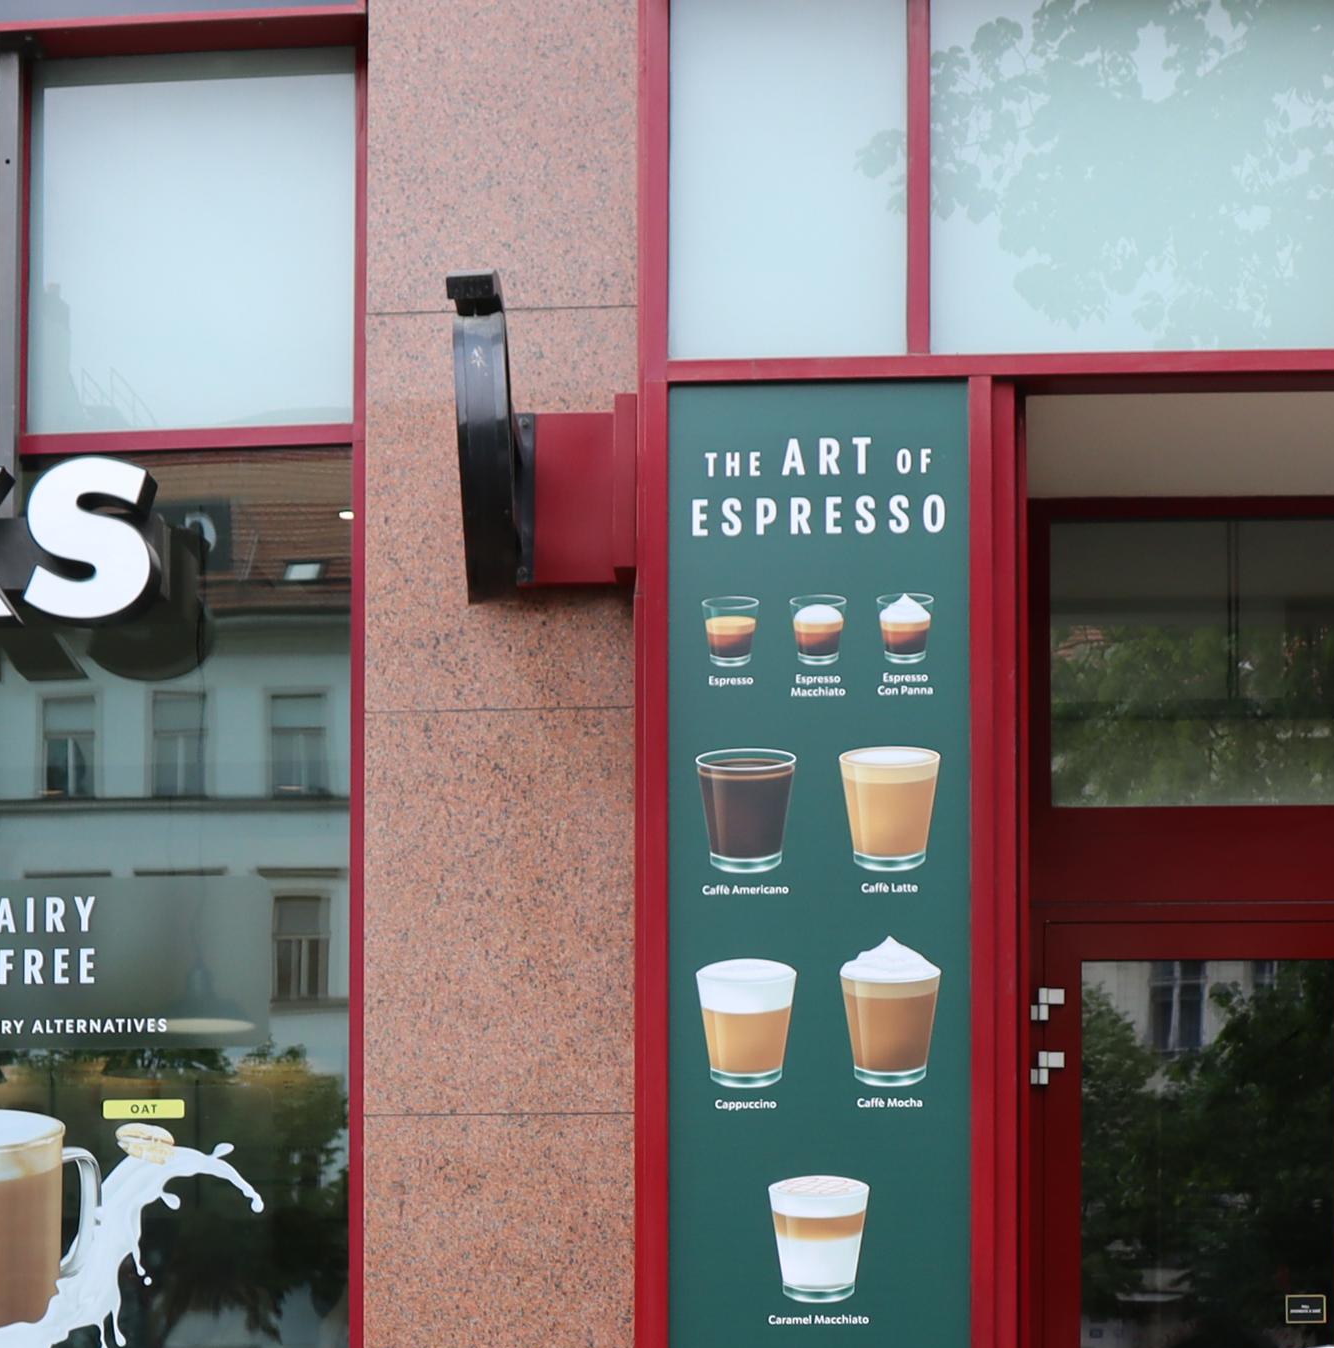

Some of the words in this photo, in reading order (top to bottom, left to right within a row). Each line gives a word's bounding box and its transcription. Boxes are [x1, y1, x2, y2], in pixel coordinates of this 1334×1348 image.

[705, 451, 762, 478] THE
[782, 436, 872, 476] ART
[896, 448, 932, 475] OF
[691, 494, 946, 537] ESPRESSO
[708, 675, 754, 687] Espresso
[795, 673, 841, 685] Espresso
[883, 672, 929, 684] Espresso
[791, 686, 846, 697] Macchiato
[878, 685, 898, 696] Con
[901, 684, 934, 695] Panna
[702, 883, 730, 895] Caffè
[732, 883, 789, 895] Americano
[861, 882, 889, 894] Caffè
[891, 882, 919, 893] Latte
[0, 948, 96, 985] FREE
[32, 1018, 168, 1034] ALTERNATIVES
[714, 1098, 777, 1111] Cappuccino
[856, 1097, 885, 1108] Caffè
[888, 1097, 923, 1108] Mocha
[129, 1103, 159, 1115] OAT
[768, 1314, 812, 1326] Caramel
[813, 1314, 869, 1326] Macchiato
